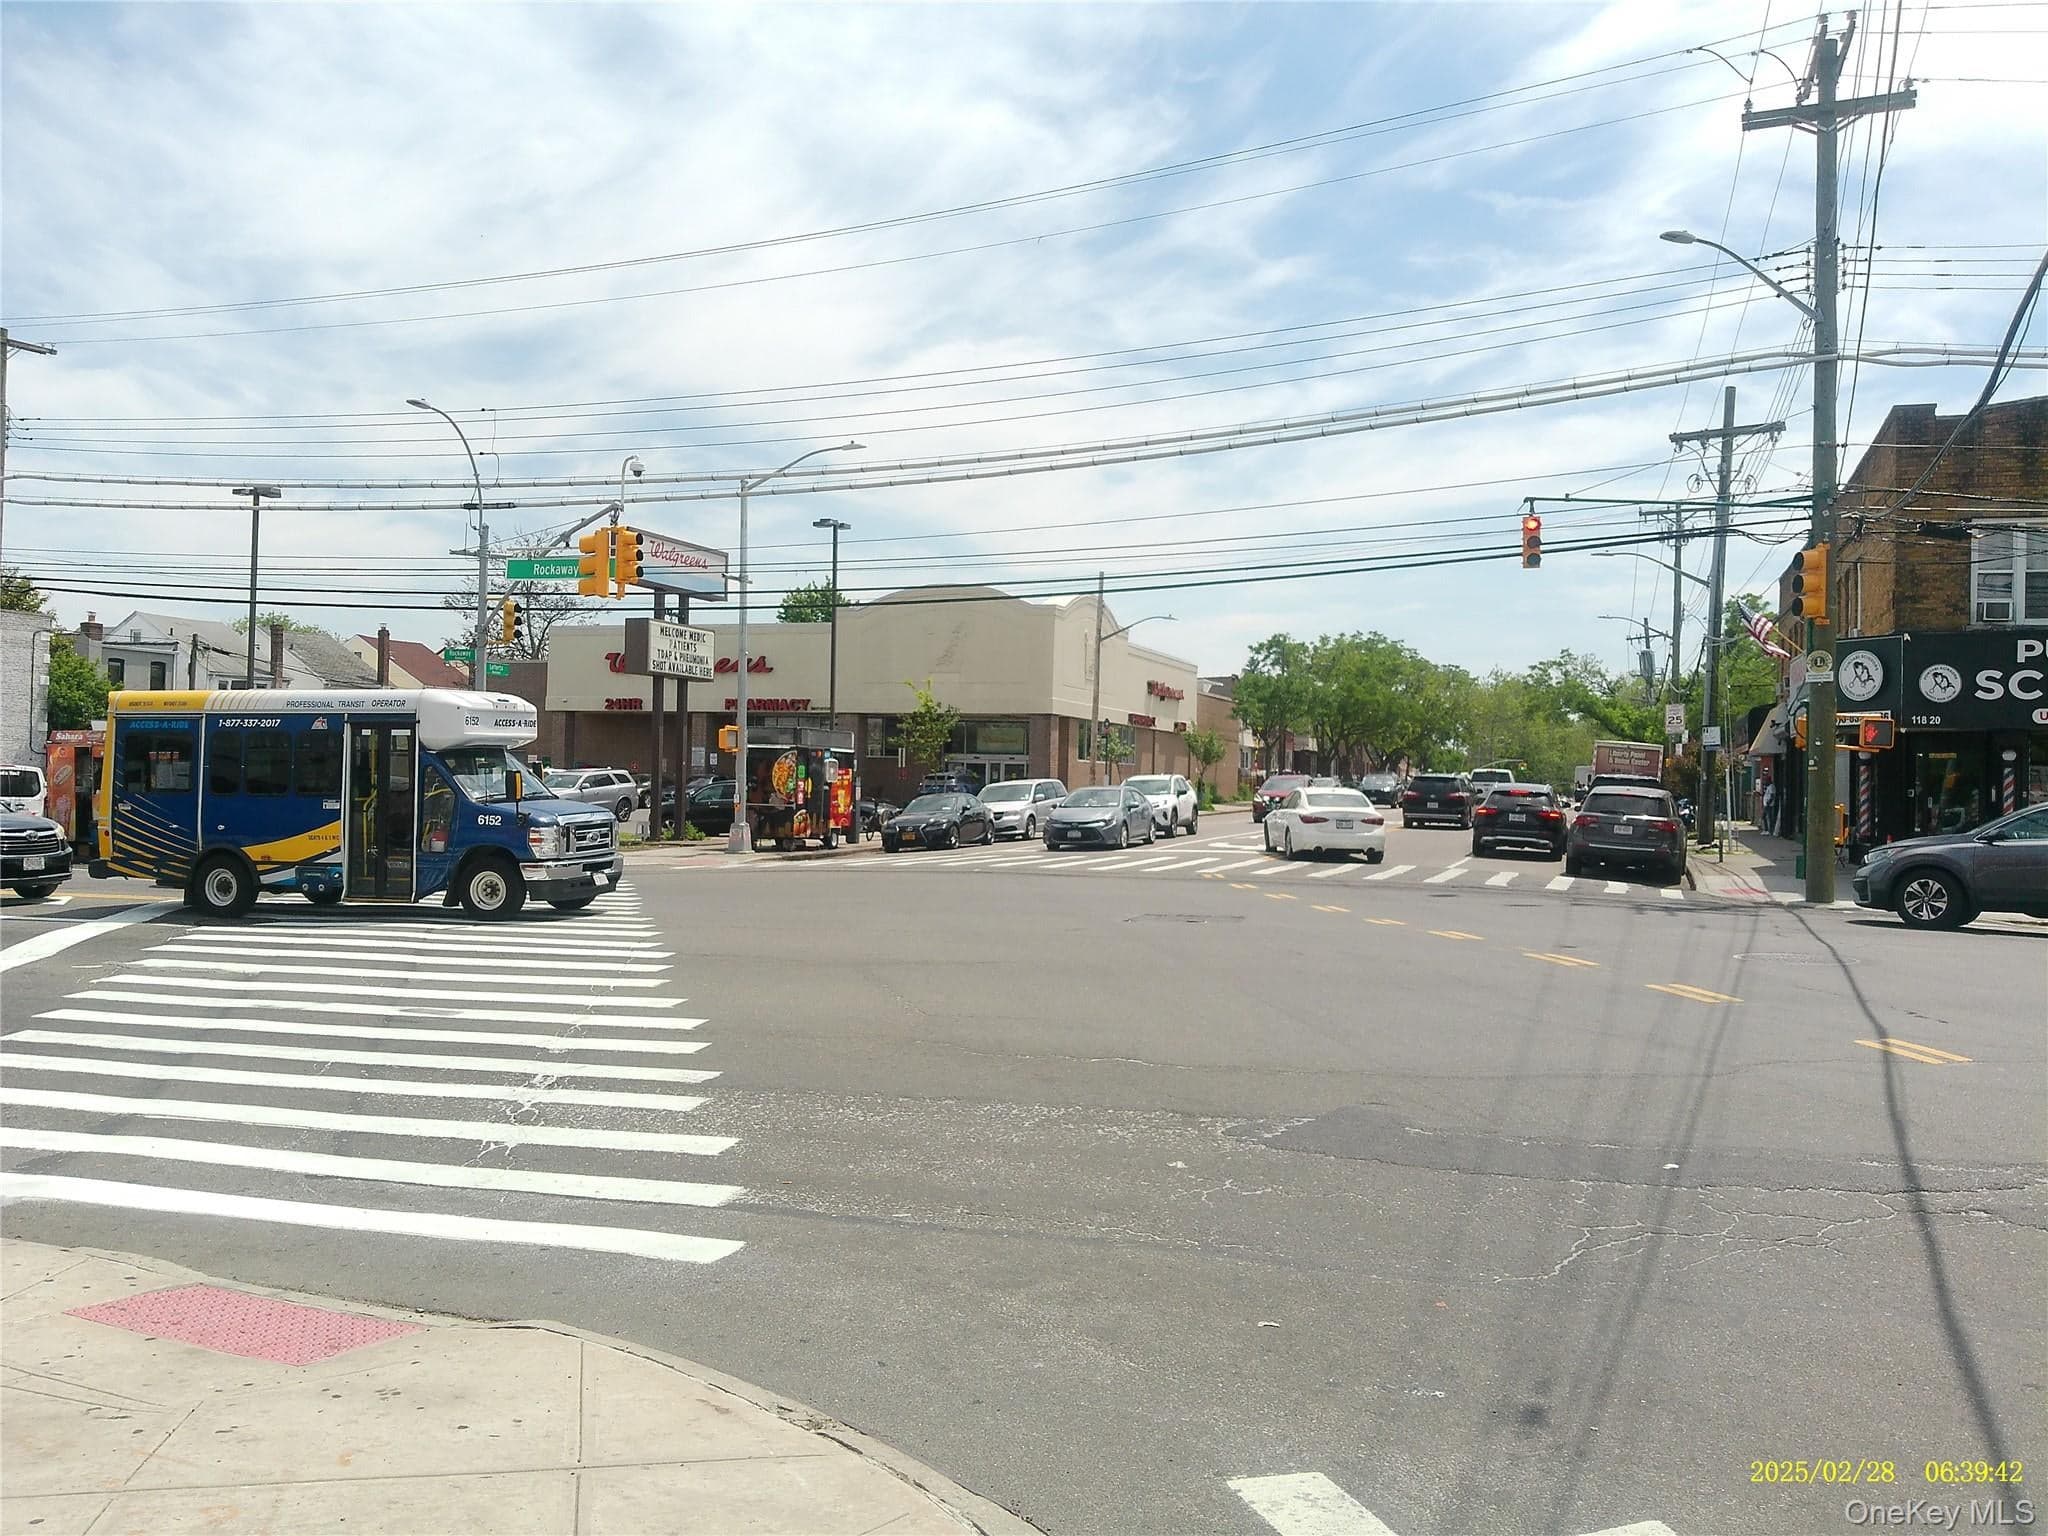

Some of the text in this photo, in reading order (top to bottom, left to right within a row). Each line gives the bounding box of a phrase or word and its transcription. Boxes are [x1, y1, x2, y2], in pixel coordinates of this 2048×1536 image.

[649, 540, 709, 569] Walgreens
[533, 564, 579, 577] Rockaway
[669, 639, 697, 653] PATIENTS
[657, 649, 672, 660] TDAP
[679, 652, 709, 665] PNEUMONIA
[652, 660, 666, 671] SHOT
[668, 662, 698, 676] AVAILABLE
[699, 666, 713, 678] HERE
[286, 700, 406, 709] PROFESSIONAL TRANSIT OPERATOR
[604, 698, 643, 711] 24HR
[218, 719, 281, 728] 1-877-337-2017
[464, 716, 480, 726] 6152
[493, 719, 537, 728] ACCESS-A-RIDE
[1668, 716, 1682, 725] 25
[1911, 715, 1941, 724] 118 20
[55, 732, 84, 741] Sahara
[478, 815, 502, 826] 6152
